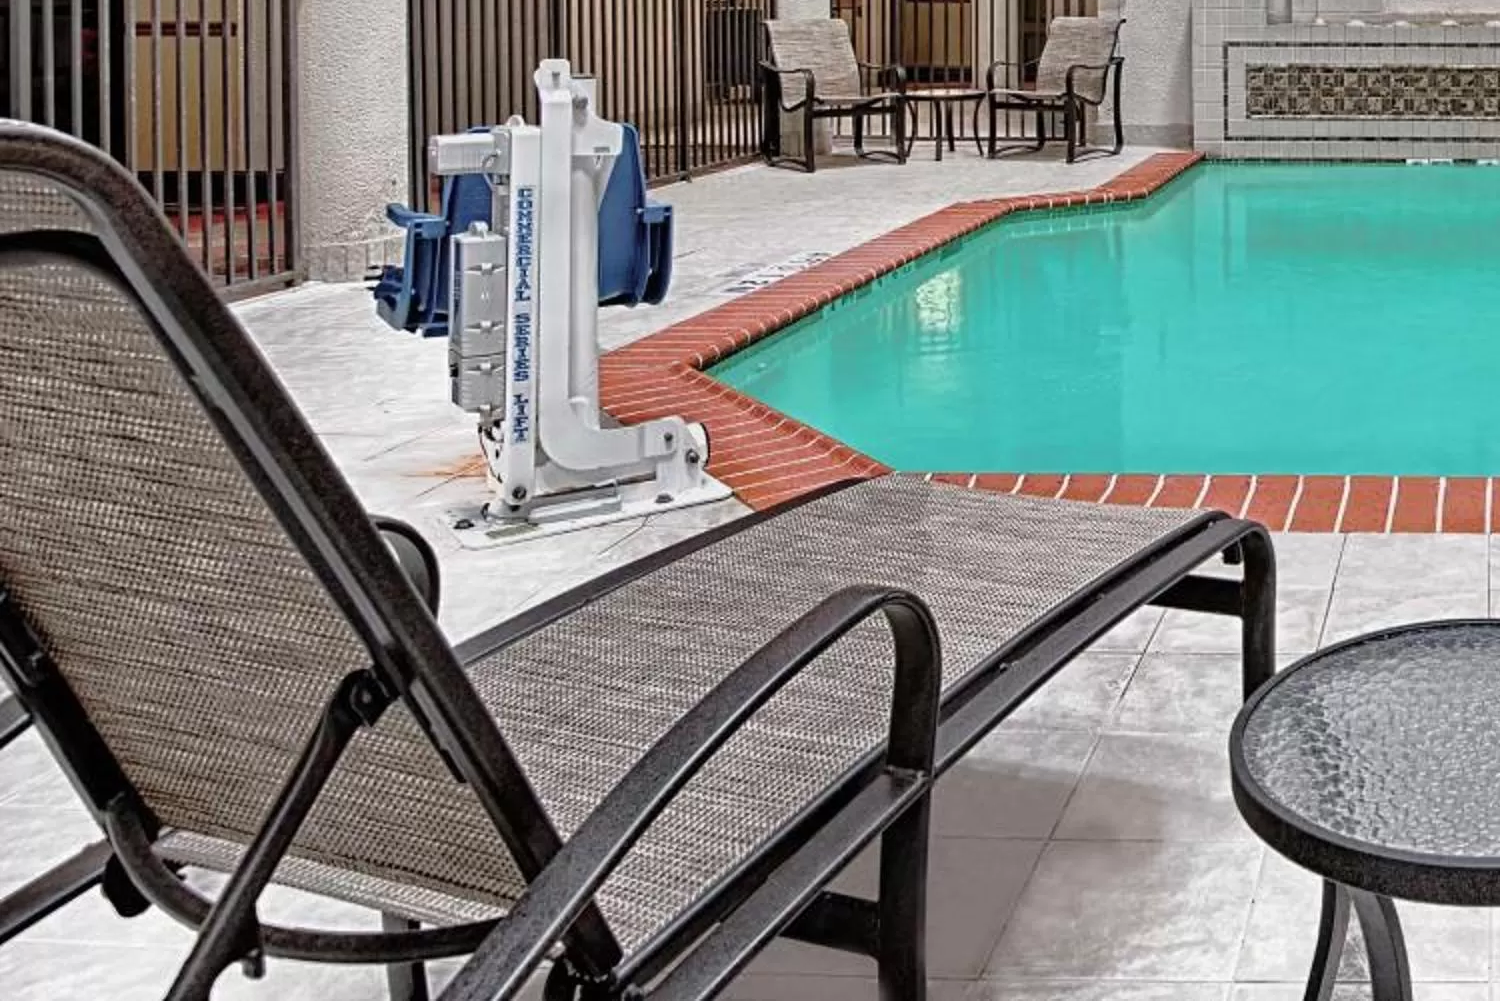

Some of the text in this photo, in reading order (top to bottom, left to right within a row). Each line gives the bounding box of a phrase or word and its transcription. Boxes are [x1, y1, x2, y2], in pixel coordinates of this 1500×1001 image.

[513, 187, 533, 443] COMMERCIAL SERIES LIFT
